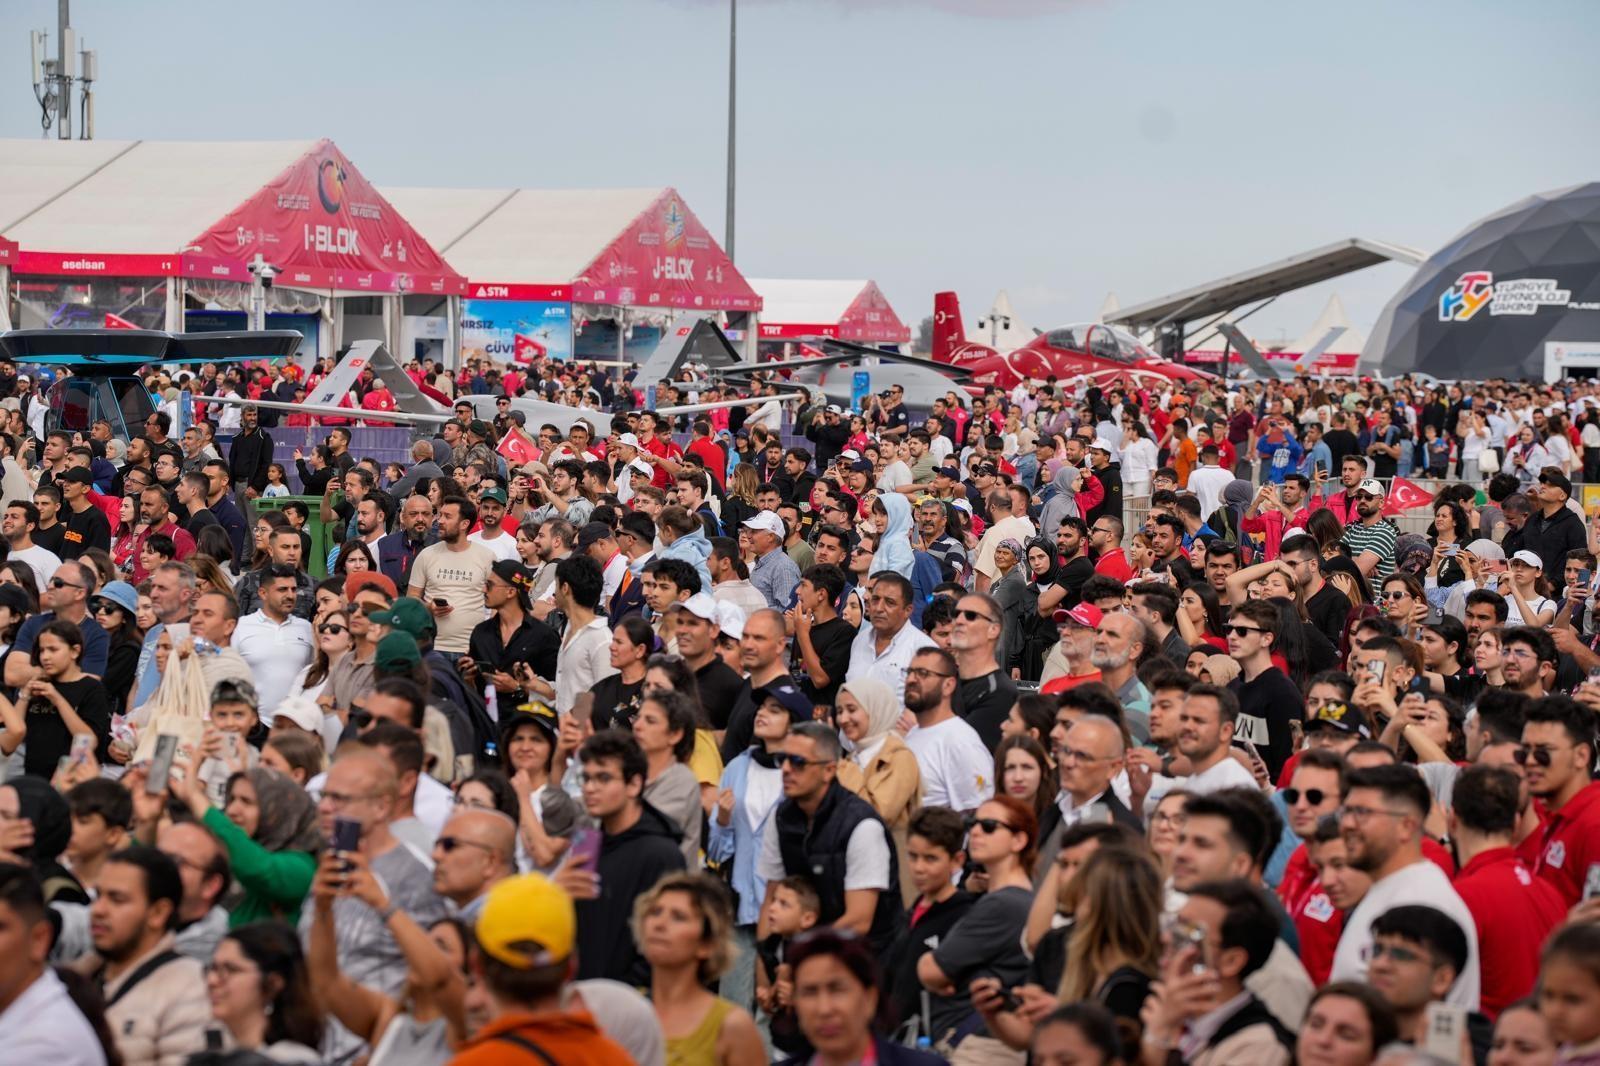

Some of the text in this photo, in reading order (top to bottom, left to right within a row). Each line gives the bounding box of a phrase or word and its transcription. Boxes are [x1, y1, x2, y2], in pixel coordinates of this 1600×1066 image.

[304, 223, 360, 256] I-BLOK
[62, 259, 105, 270] aselsan
[653, 256, 694, 281] J-BLOK
[763, 325, 783, 335] TRT
